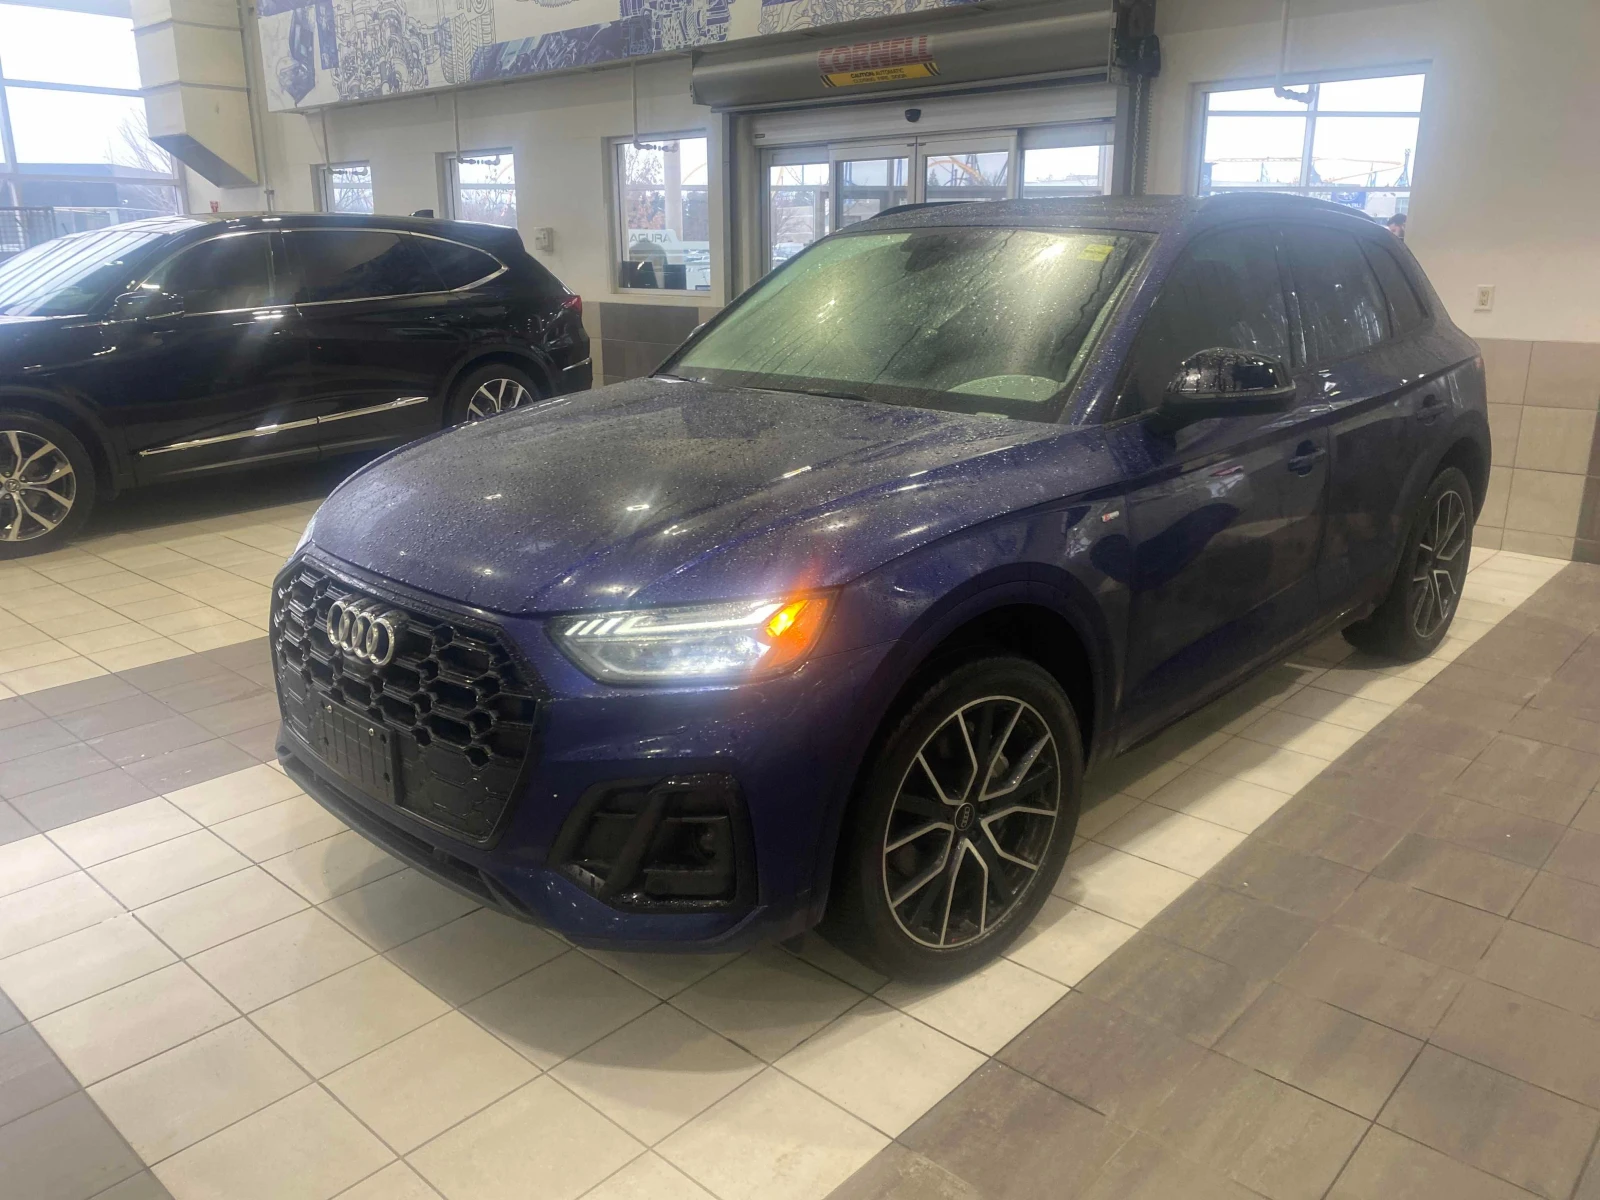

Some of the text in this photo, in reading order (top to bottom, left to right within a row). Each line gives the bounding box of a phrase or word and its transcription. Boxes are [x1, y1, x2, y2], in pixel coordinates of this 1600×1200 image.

[818, 34, 933, 73] CORNELL
[876, 67, 904, 76] AUTOMATIC
[629, 233, 672, 243] ACURA
